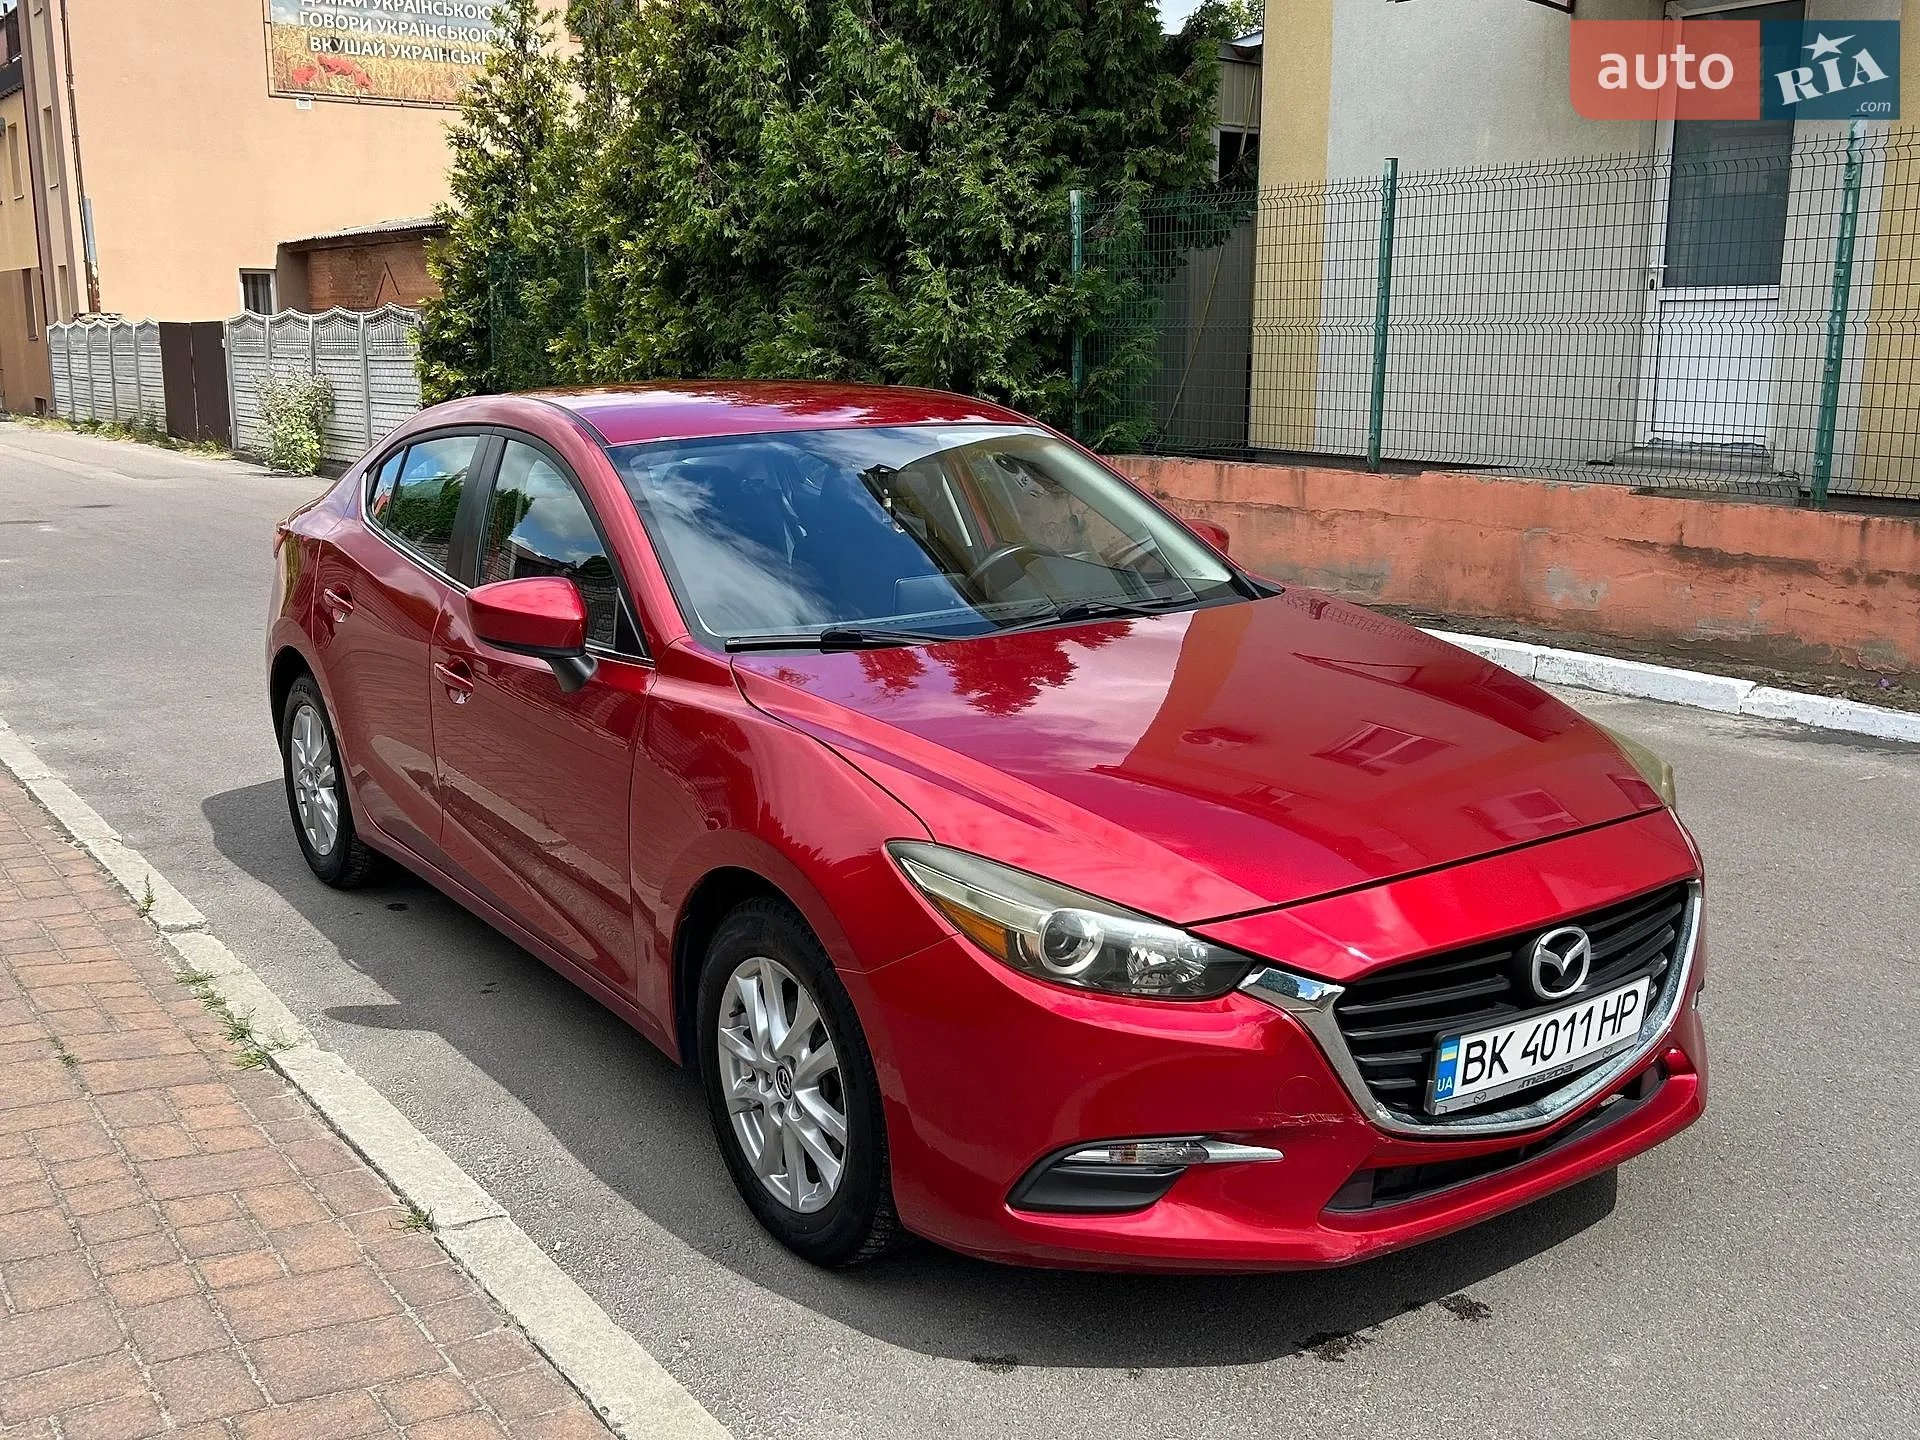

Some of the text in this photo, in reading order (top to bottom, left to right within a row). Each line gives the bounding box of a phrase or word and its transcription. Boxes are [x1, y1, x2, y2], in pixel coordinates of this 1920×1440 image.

[300, 11, 497, 43] ГОВОРИ УКРАЇНСЬКОЮ
[310, 36, 386, 58] ВКУШАЙ
[1461, 989, 1639, 1087] BK 4011 HP
[1437, 1076, 1454, 1093] UA
